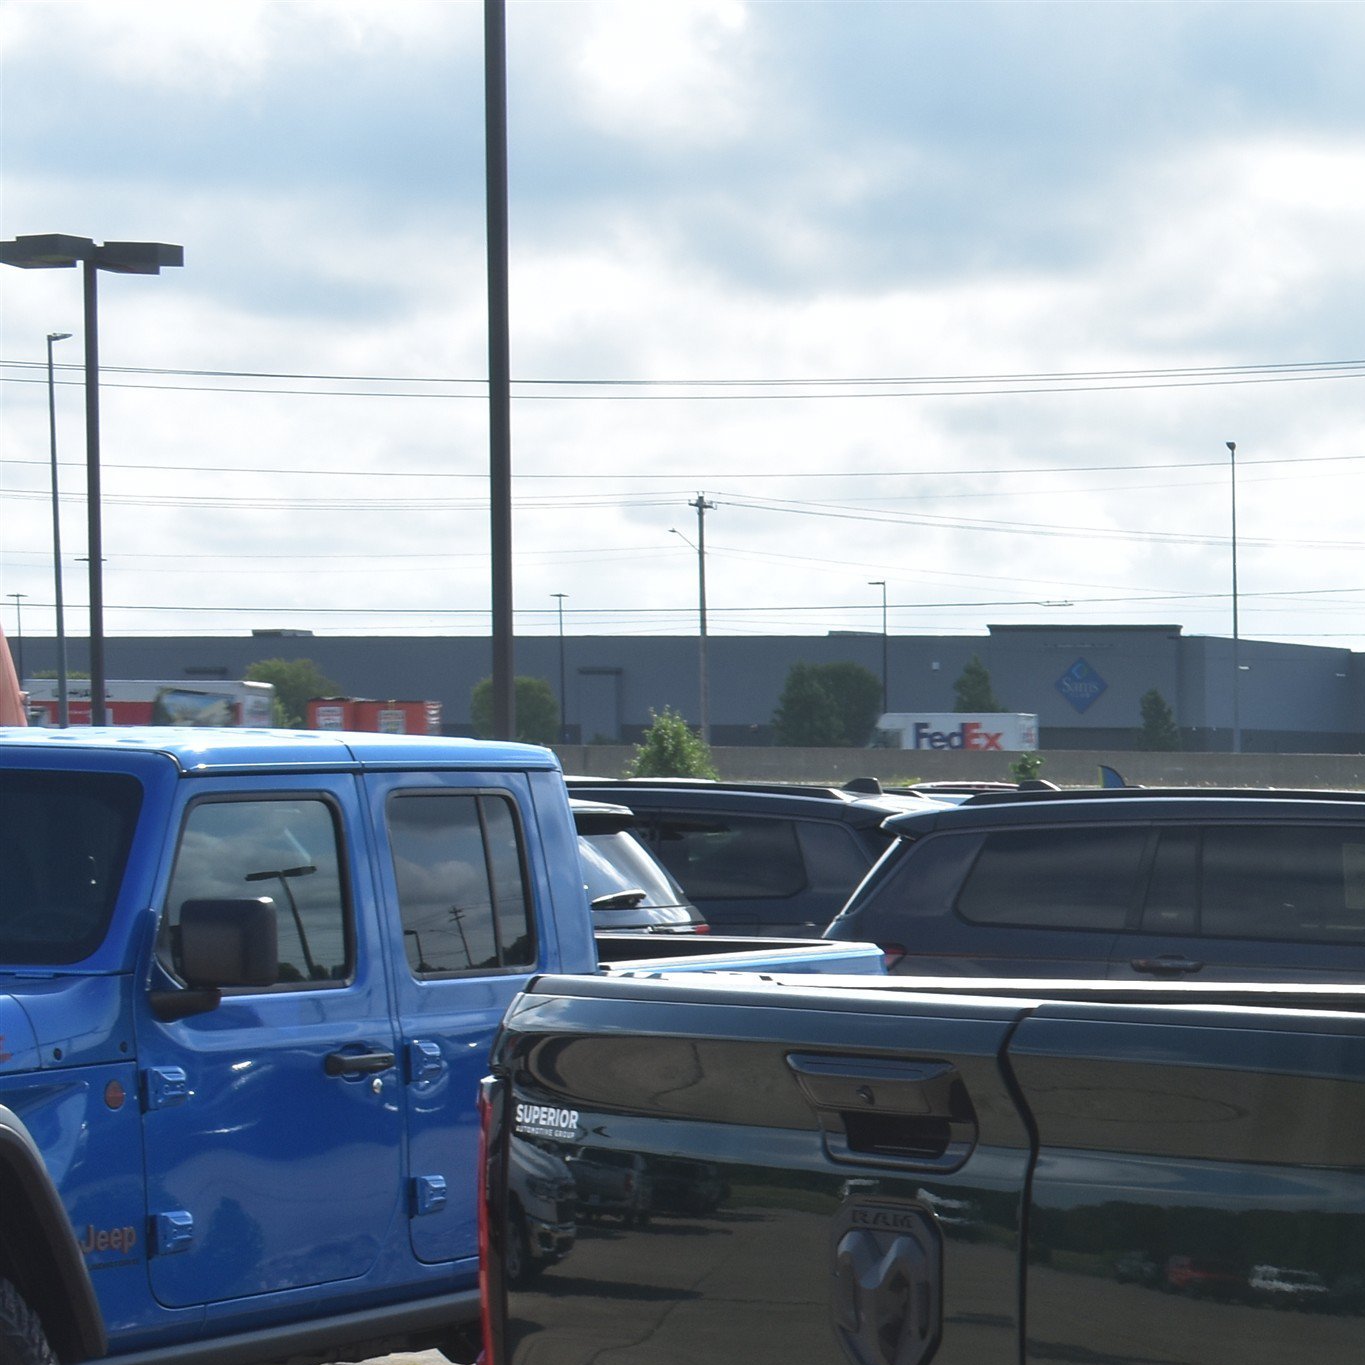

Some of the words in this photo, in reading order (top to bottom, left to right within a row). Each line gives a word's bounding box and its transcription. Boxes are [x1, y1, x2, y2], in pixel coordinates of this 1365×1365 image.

[914, 722, 1003, 750] FedEx
[516, 1104, 579, 1129] SUPERIOR
[554, 1131, 576, 1139] GROUP
[851, 1210, 914, 1229] RAM
[80, 1224, 137, 1254] Jeep
